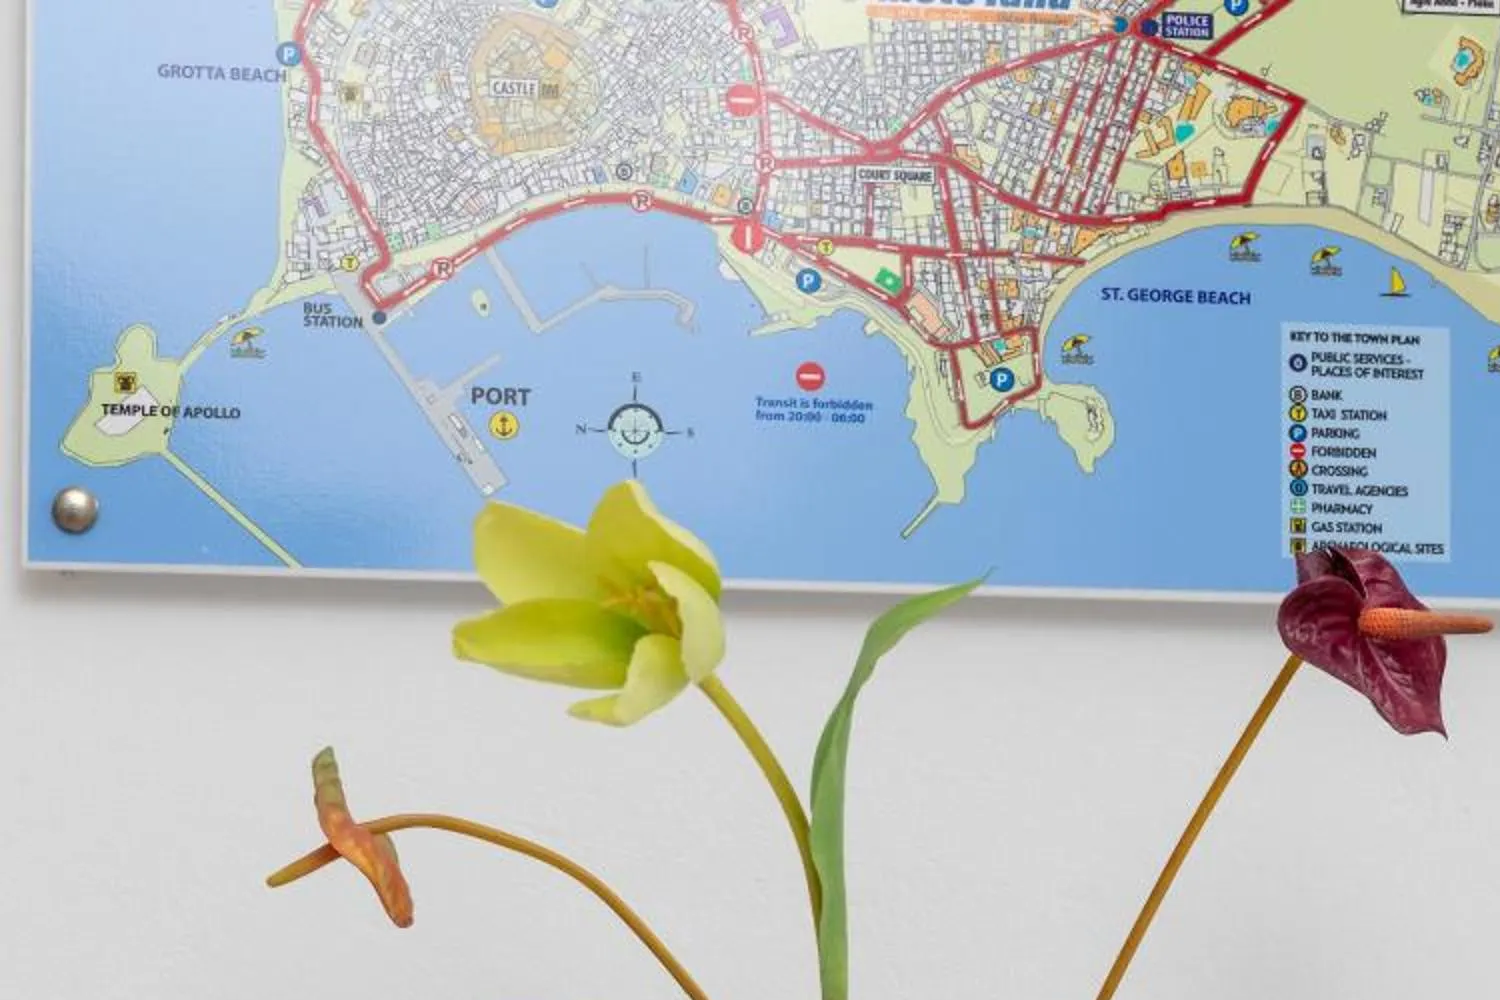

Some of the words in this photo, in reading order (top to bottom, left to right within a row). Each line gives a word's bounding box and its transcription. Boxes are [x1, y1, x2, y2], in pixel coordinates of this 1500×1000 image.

[1166, 14, 1209, 27] POLICE
[1165, 27, 1209, 38] STATION
[157, 63, 226, 80] GROTTA
[230, 66, 287, 82] BEACH
[493, 81, 535, 95] CASTLE
[858, 168, 892, 181] COURT
[894, 169, 933, 183] SQUARE
[1100, 287, 1124, 301] ST.
[1127, 288, 1193, 304] GEORGE
[1197, 290, 1251, 305] BEACH
[303, 302, 333, 314] BUS
[303, 316, 364, 328] STATION
[1289, 331, 1311, 342] KEY
[1313, 331, 1329, 343] TO
[1332, 332, 1353, 343] THE
[1355, 333, 1389, 345] TOWN
[1391, 334, 1421, 346] PLAN
[1311, 351, 1350, 364] PUBLIC
[1353, 352, 1404, 366] SERVICES
[1311, 365, 1352, 377] PLACES
[1354, 366, 1371, 378] OF
[1373, 367, 1425, 380] INTEREST
[470, 386, 532, 407] PORT
[1311, 389, 1344, 401] BANK
[755, 396, 797, 409] Transit
[800, 397, 810, 409] is
[811, 397, 874, 411] forbidden
[101, 403, 159, 418] TEMPLE
[161, 405, 178, 418] OF
[182, 406, 241, 420] APOLLO
[755, 409, 785, 421] from
[1311, 408, 1337, 420] TAXI
[1341, 409, 1388, 421] STATION
[1311, 427, 1361, 439] PARKING
[1311, 446, 1377, 459] FORBIDDEN
[1311, 465, 1369, 478] CROSSING
[1312, 483, 1351, 496] TRAVEL
[1355, 484, 1409, 497] AGENCIES
[1311, 502, 1374, 515] PHARMACY
[1311, 521, 1335, 533] GAS
[1336, 522, 1383, 534] STATION
[1414, 543, 1445, 555] SITES
